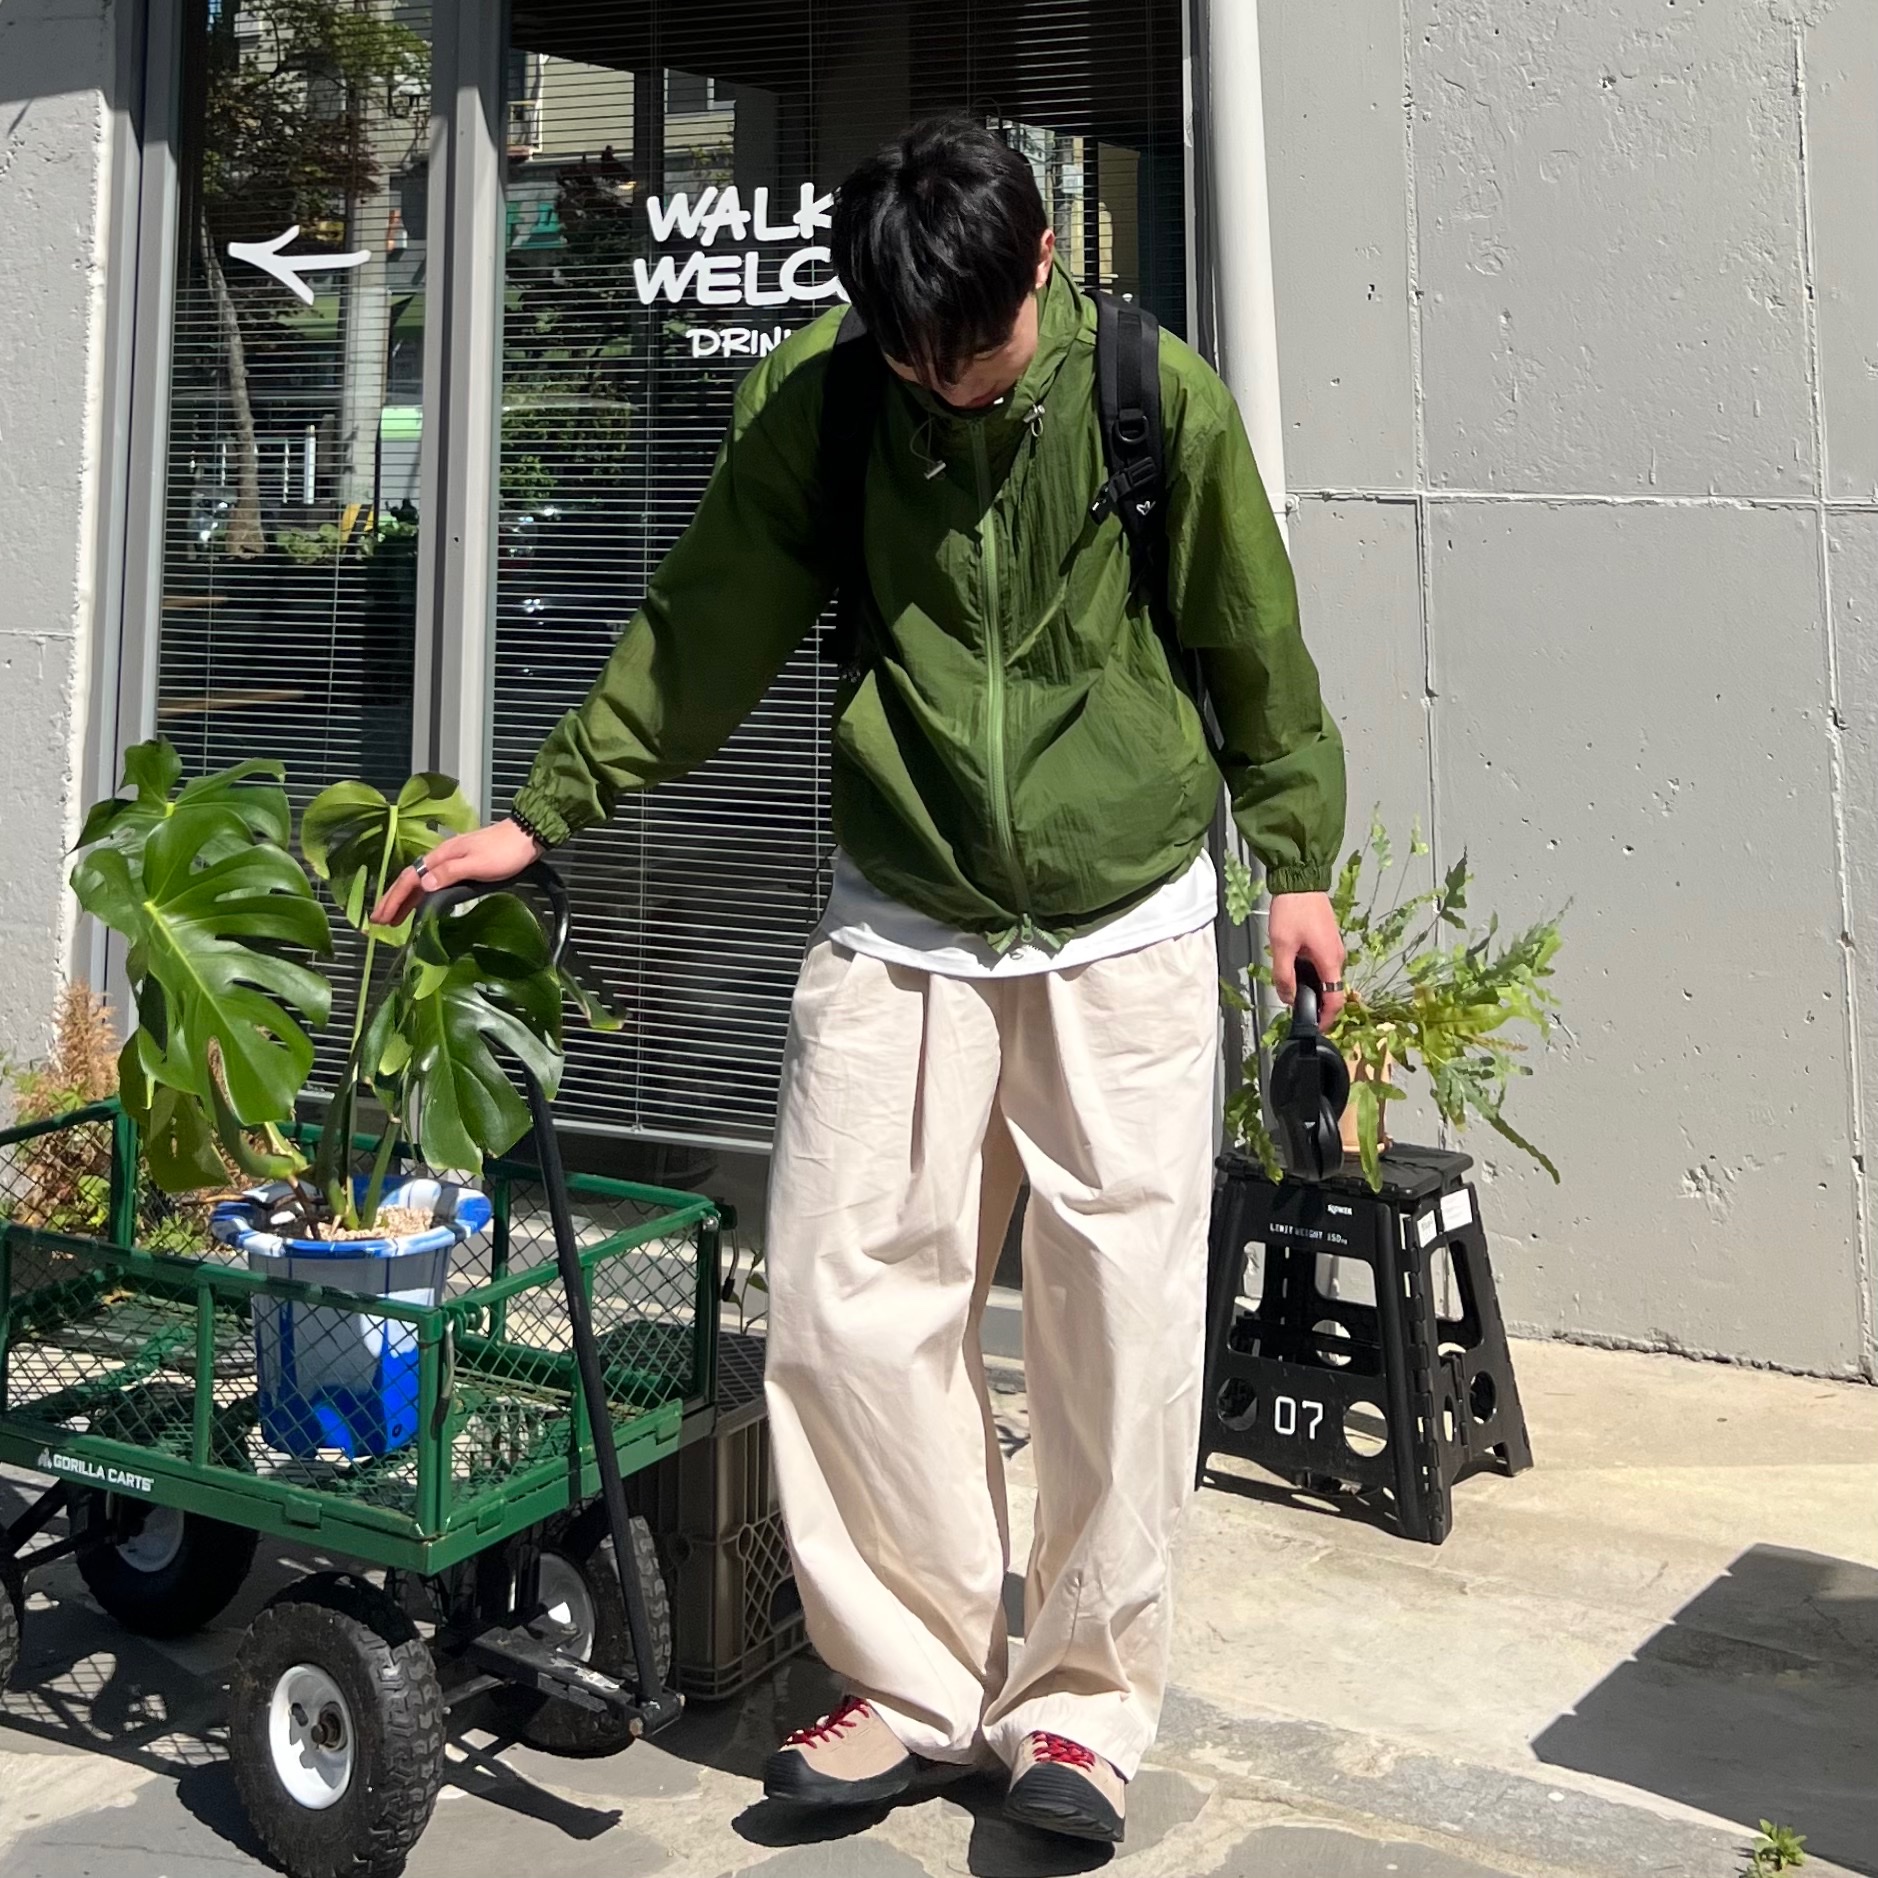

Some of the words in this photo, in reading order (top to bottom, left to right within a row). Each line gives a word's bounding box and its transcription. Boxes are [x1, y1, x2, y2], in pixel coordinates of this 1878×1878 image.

[647, 182, 840, 246] WALK
[633, 246, 851, 306] WELC
[685, 326, 792, 358] DRIN
[1274, 1396, 1324, 1440] 07
[53, 1453, 106, 1480] GORILLA
[107, 1467, 152, 1492] CARTS
